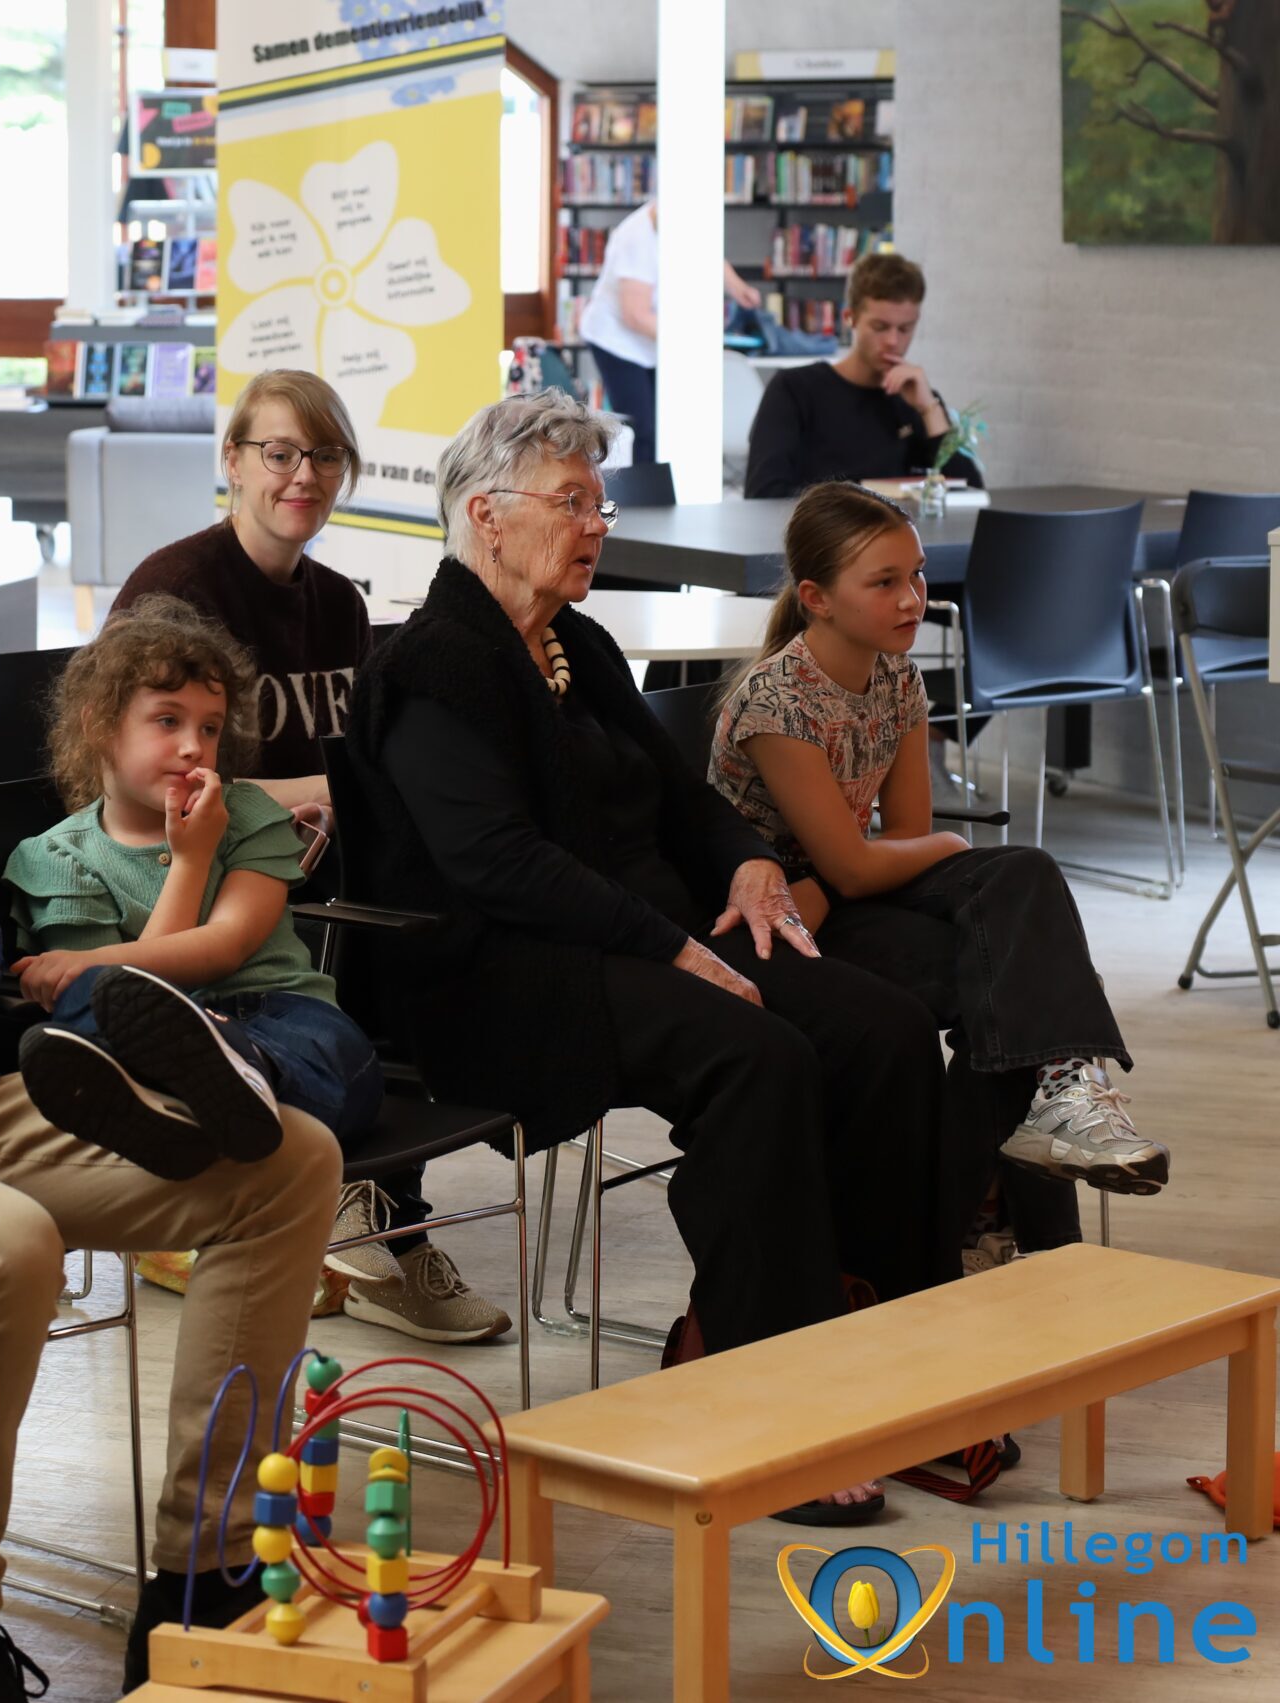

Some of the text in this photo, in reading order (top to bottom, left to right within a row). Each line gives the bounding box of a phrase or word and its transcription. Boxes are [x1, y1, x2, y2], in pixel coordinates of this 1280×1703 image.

[252, 1, 486, 63] Samen dementievriendelijk
[381, 465, 409, 481] van
